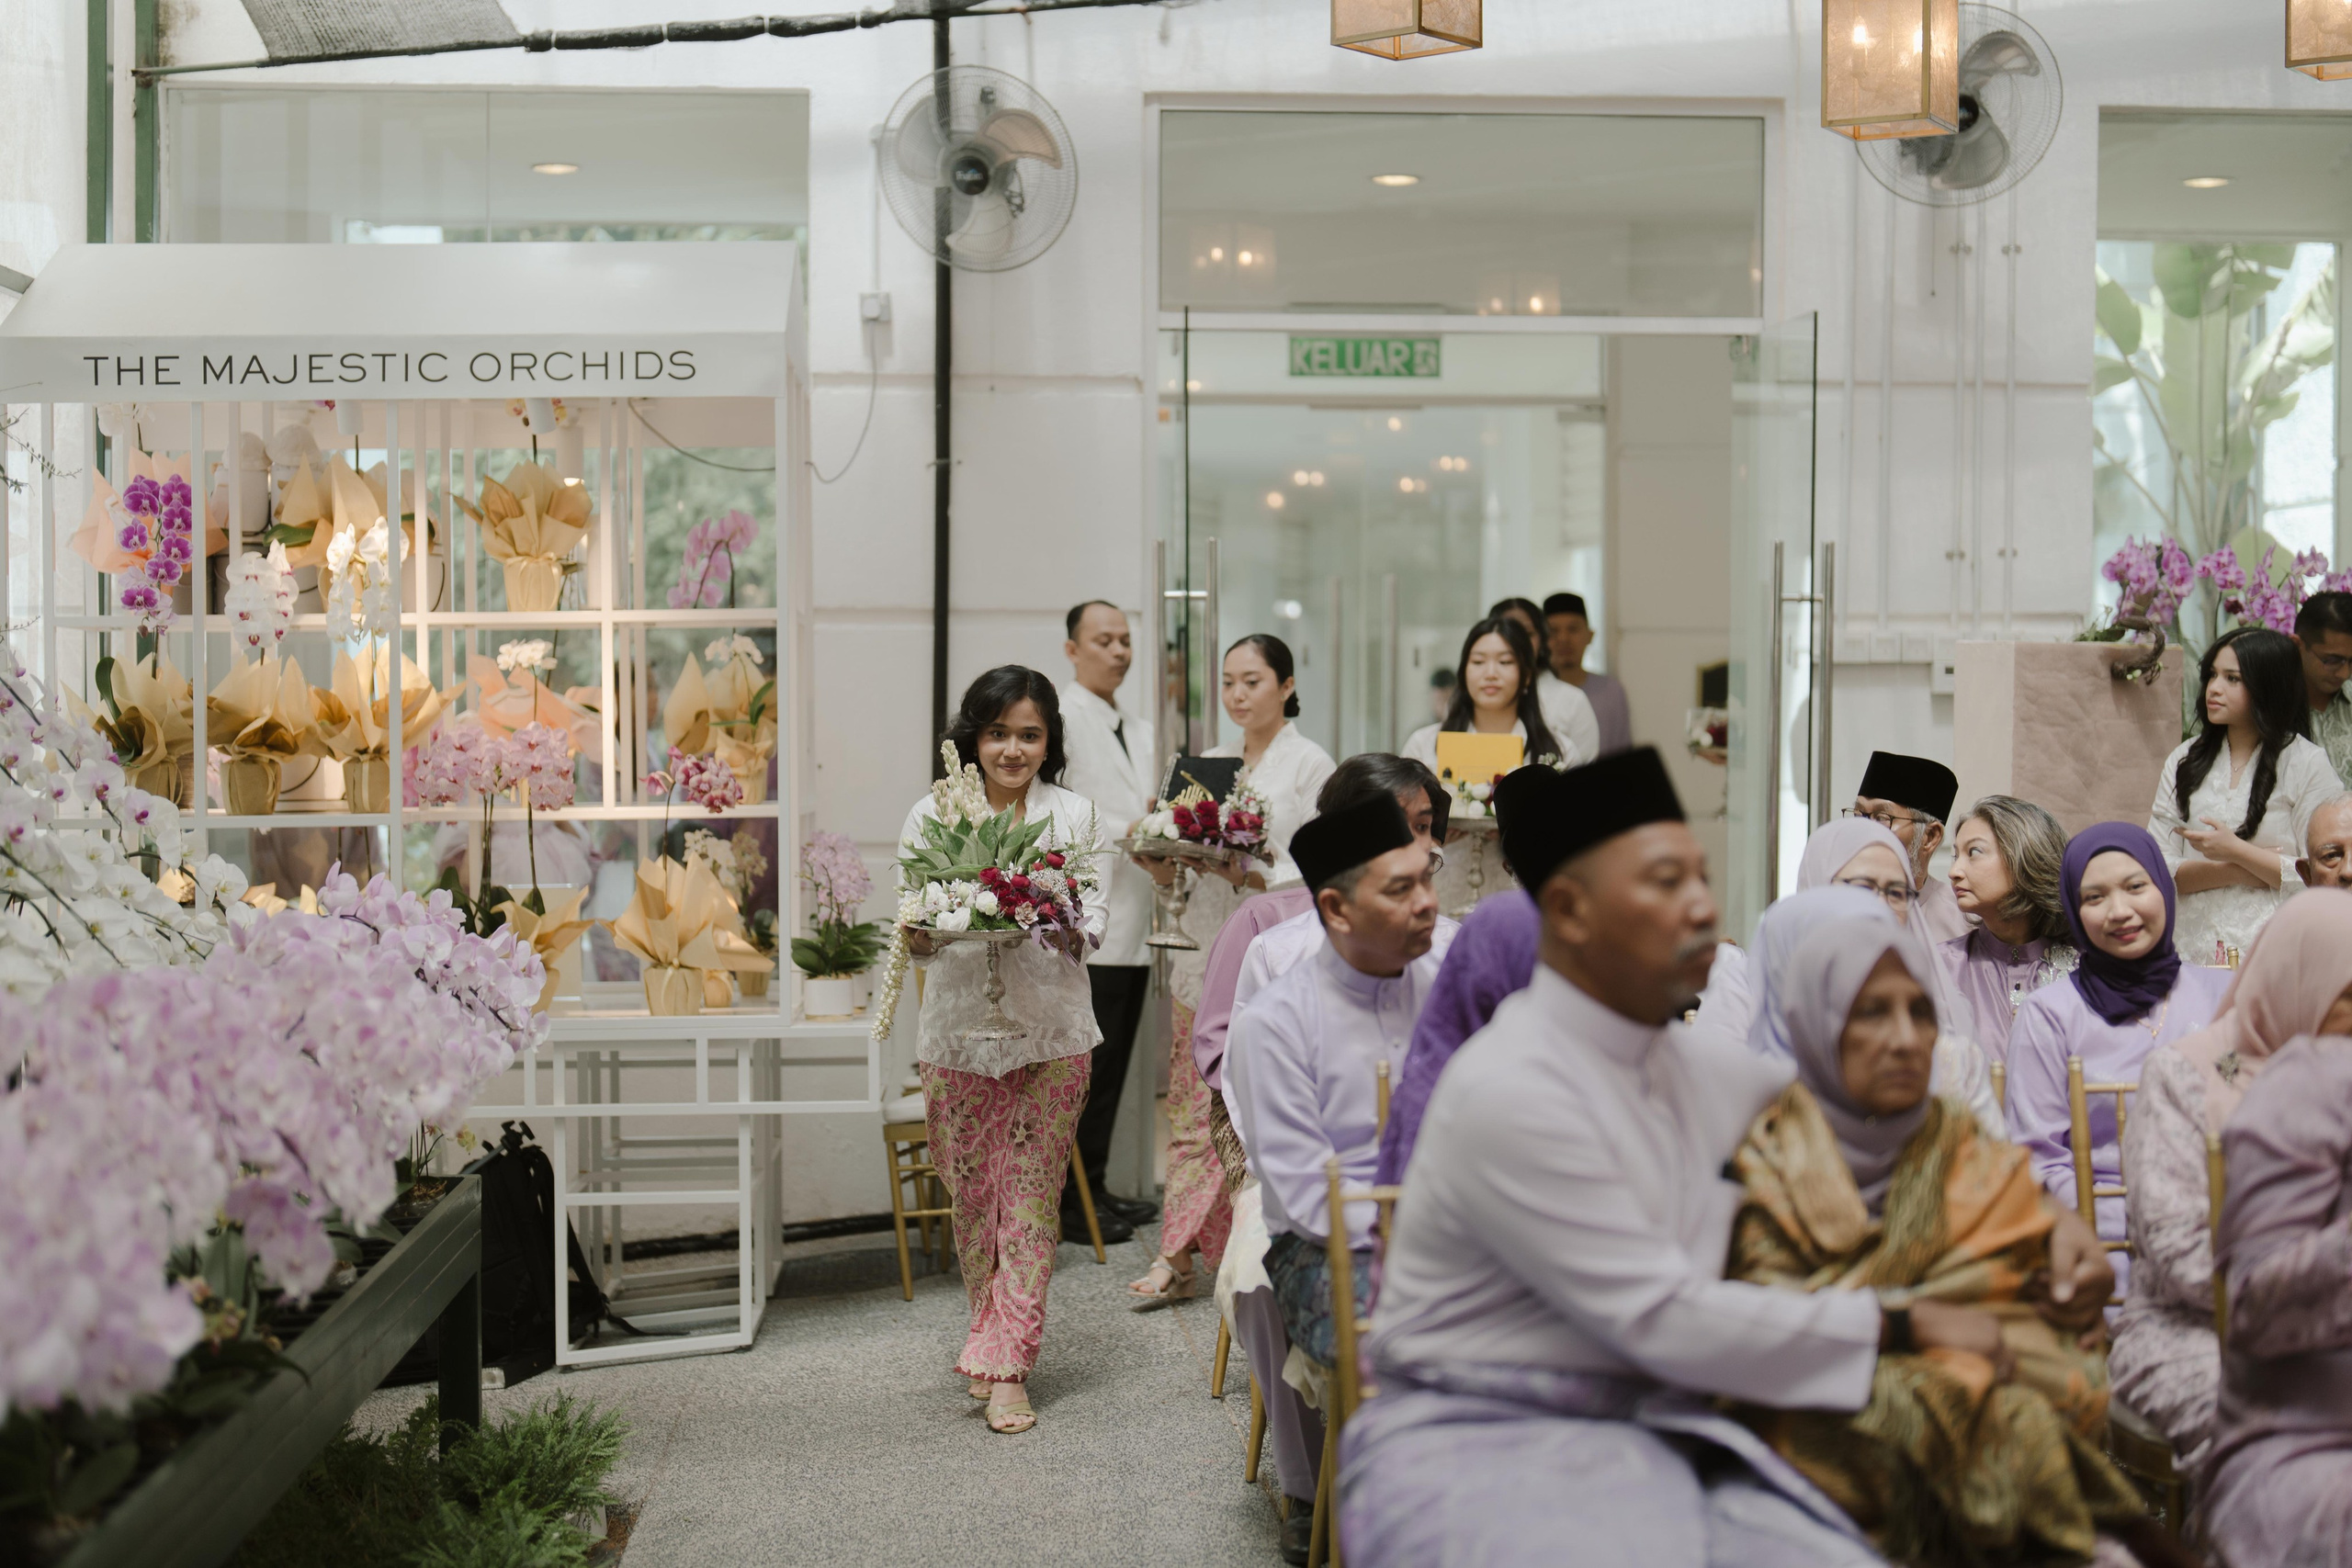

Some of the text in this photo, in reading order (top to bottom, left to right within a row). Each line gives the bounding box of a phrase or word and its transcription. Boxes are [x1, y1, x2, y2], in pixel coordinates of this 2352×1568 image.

[83, 350, 695, 386] THE MAJESTIC ORCHIDS
[1292, 340, 1409, 375] KELUAR
